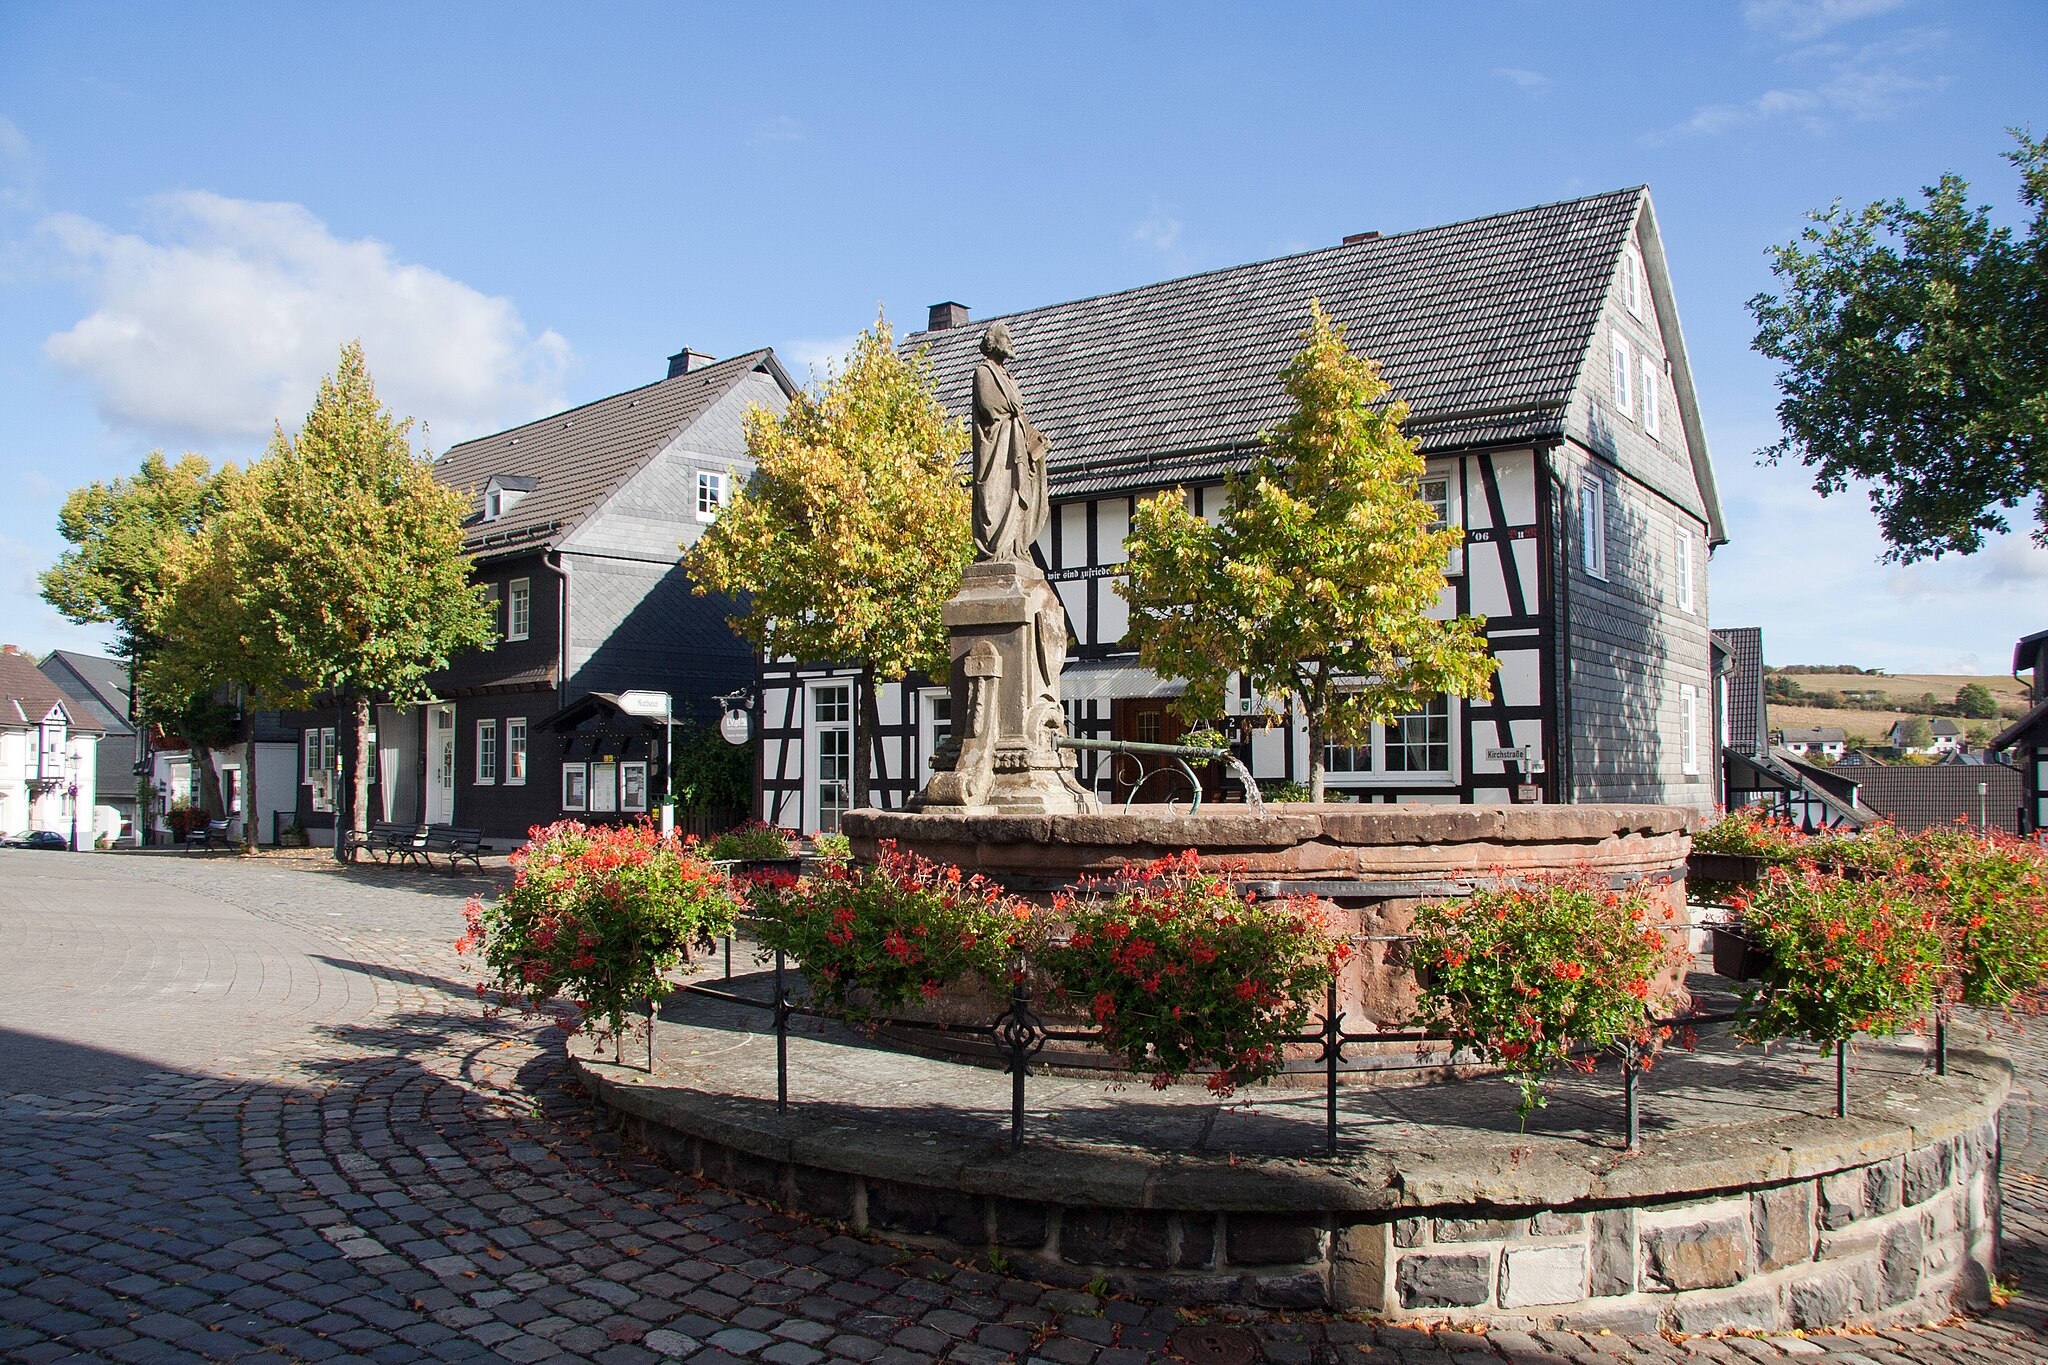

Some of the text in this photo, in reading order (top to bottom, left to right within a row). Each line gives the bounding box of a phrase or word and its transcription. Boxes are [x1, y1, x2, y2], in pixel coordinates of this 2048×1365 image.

[1048, 567, 1112, 580] wir sind zufriede
[1229, 717, 1235, 727] 2
[1487, 750, 1524, 759] Kirchstraße
